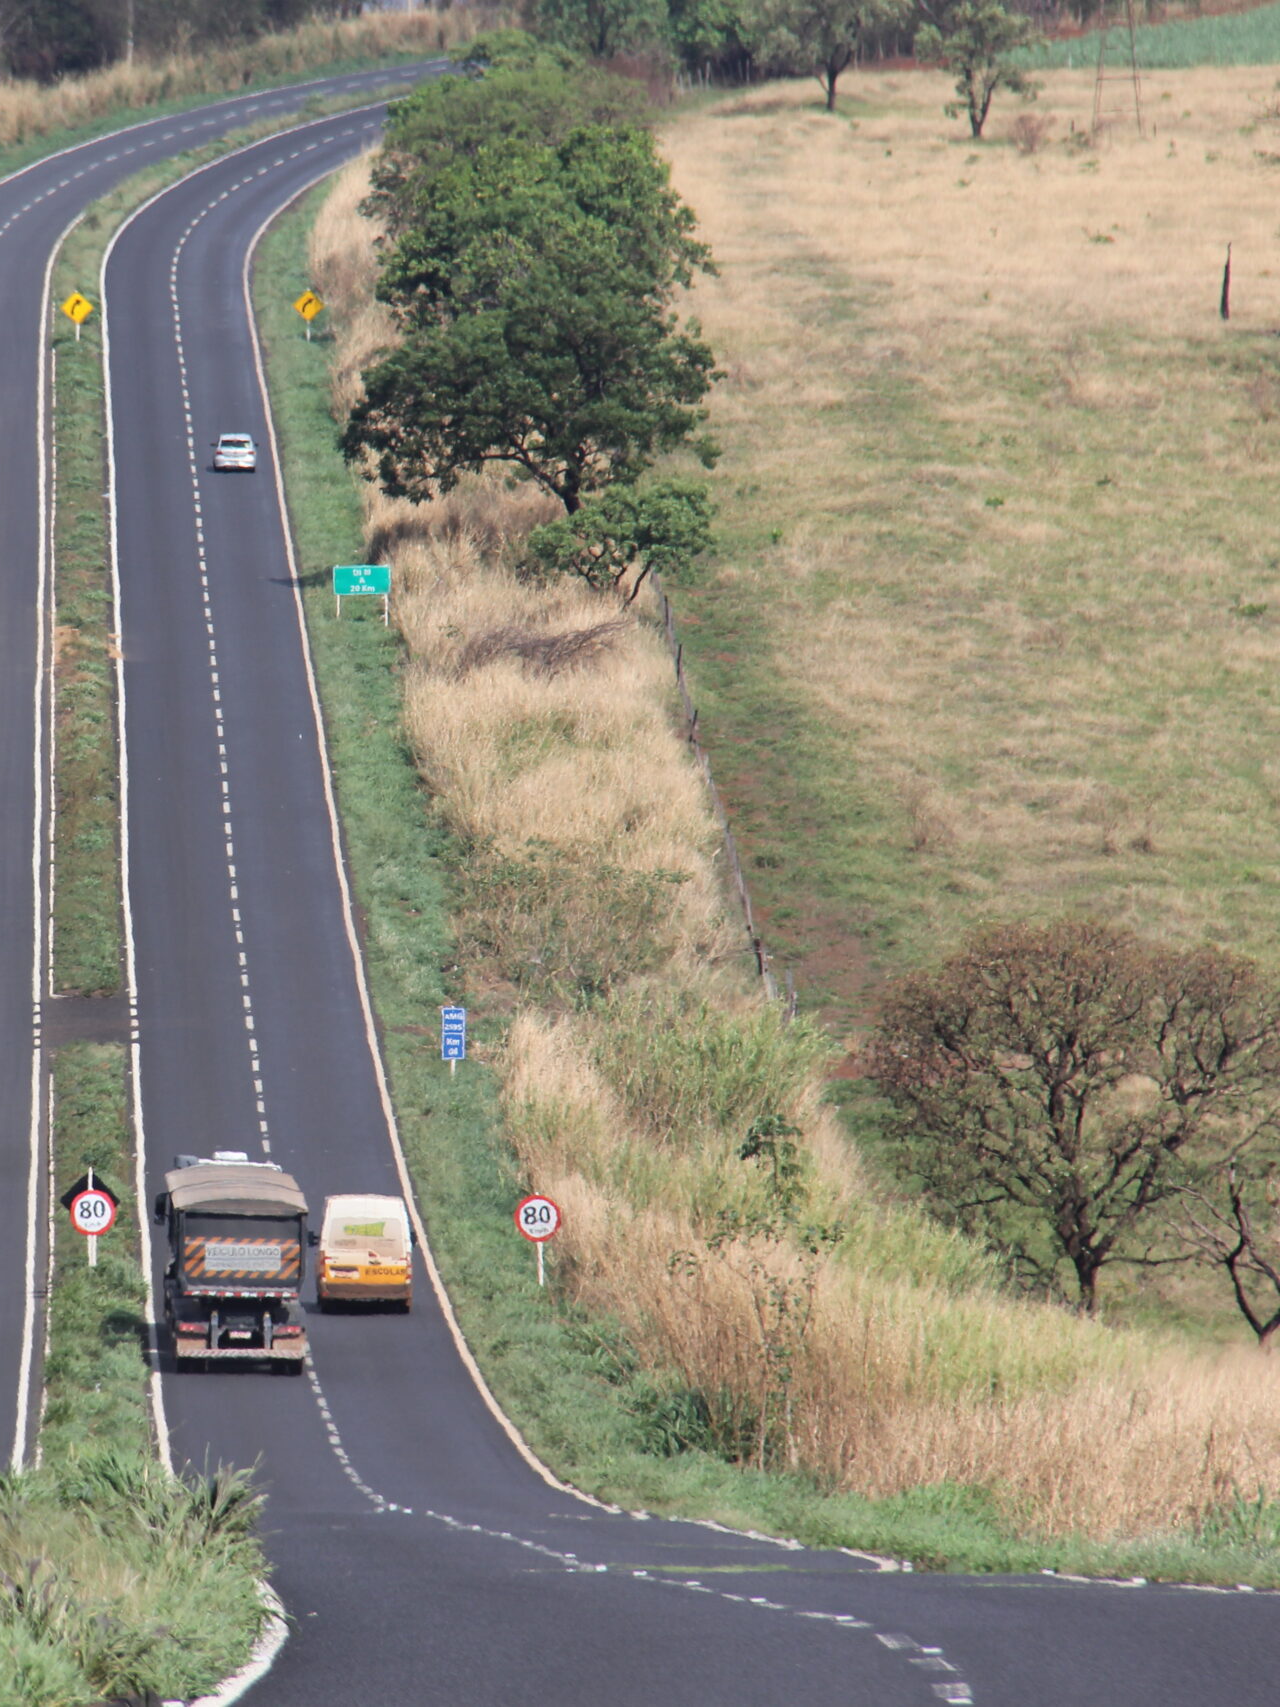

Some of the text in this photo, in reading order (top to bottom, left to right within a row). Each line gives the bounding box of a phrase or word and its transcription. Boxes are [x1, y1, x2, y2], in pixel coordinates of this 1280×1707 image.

[361, 584, 375, 592] Km
[446, 1038, 460, 1046] Km
[79, 1200, 106, 1219] 80
[523, 1205, 551, 1225] 80
[247, 1247, 280, 1257] LONGO
[364, 1267, 406, 1275] ESCOLAR
